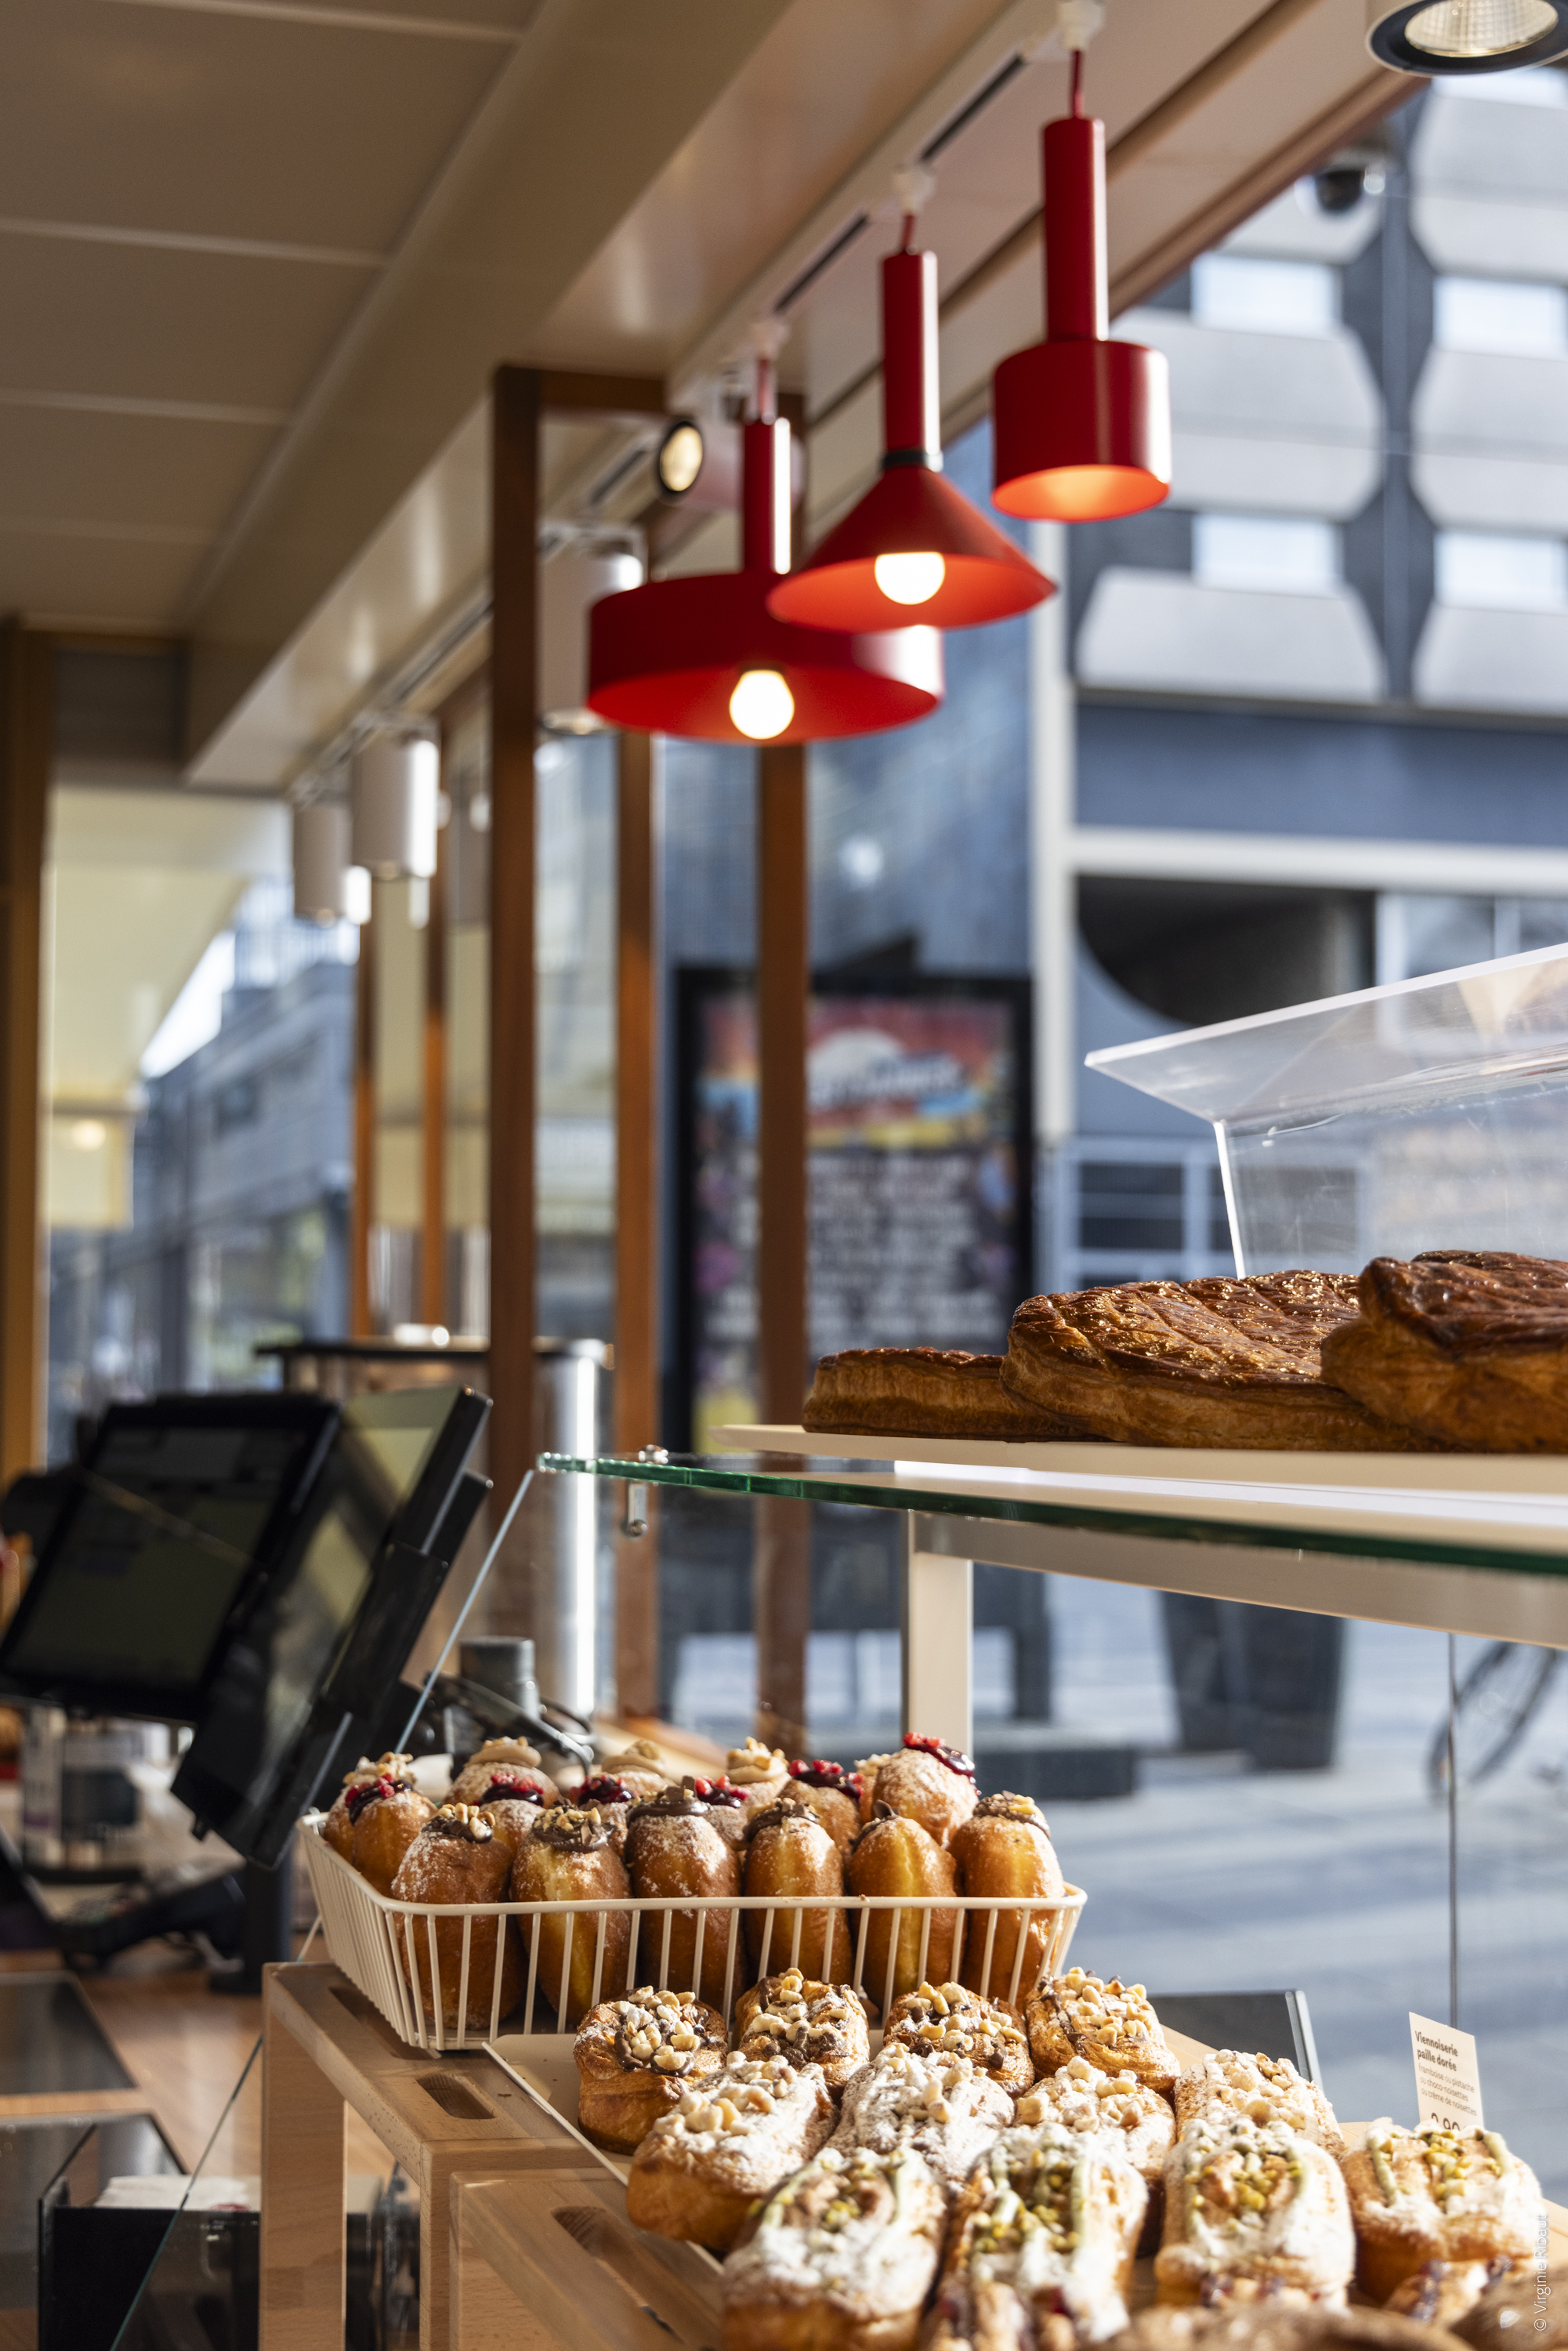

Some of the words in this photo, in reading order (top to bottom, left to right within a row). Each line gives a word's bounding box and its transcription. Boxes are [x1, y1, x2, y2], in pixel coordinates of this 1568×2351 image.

[1414, 2030, 1458, 2057] Viennoiserie
[1417, 2049, 1436, 2063] paille
[1436, 2054, 1457, 2072] dorée
[1418, 2063, 1443, 2081] framboise
[1452, 2078, 1475, 2093] pistache
[1427, 2078, 1468, 2102] choco-noisettes
[1428, 2090, 1444, 2103] crème
[1445, 2096, 1452, 2106] de
[1452, 2101, 1477, 2117] noisettes
